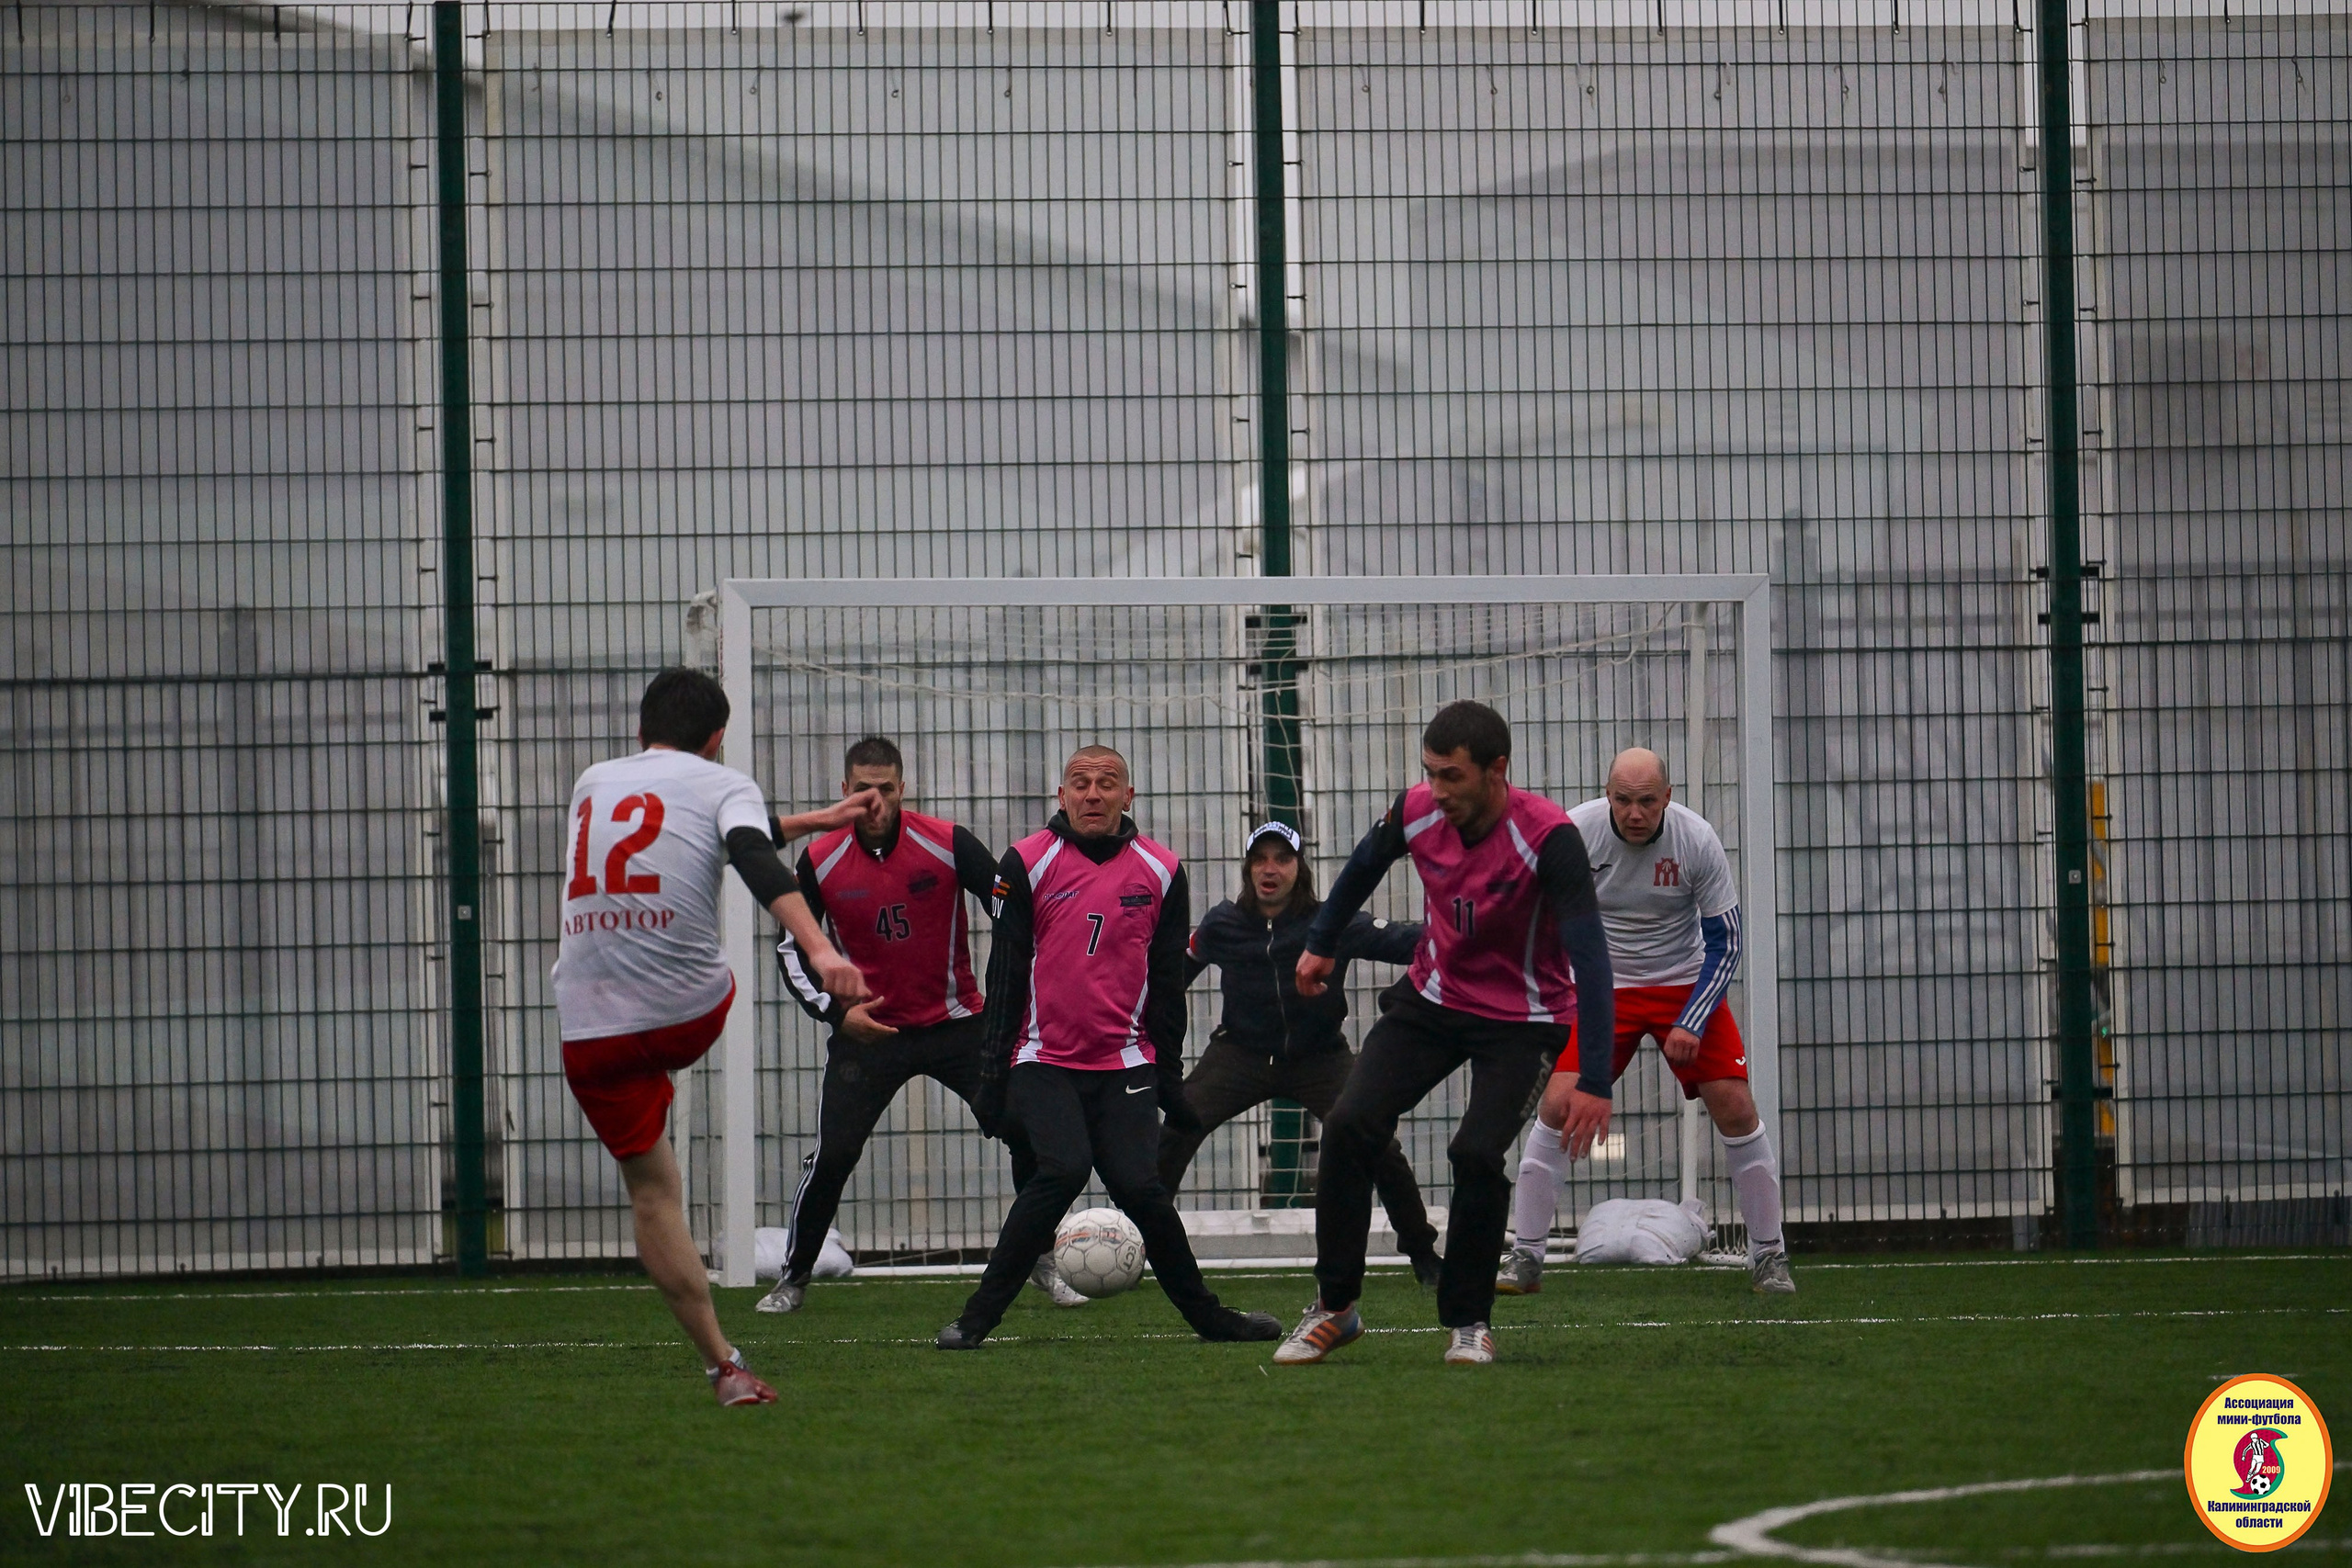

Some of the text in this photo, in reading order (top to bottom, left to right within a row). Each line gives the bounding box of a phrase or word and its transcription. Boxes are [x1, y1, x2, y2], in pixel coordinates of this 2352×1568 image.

[568, 793, 665, 901] 12
[876, 904, 910, 942] 45
[1086, 913, 1104, 956] 7
[1452, 896, 1475, 939] 11
